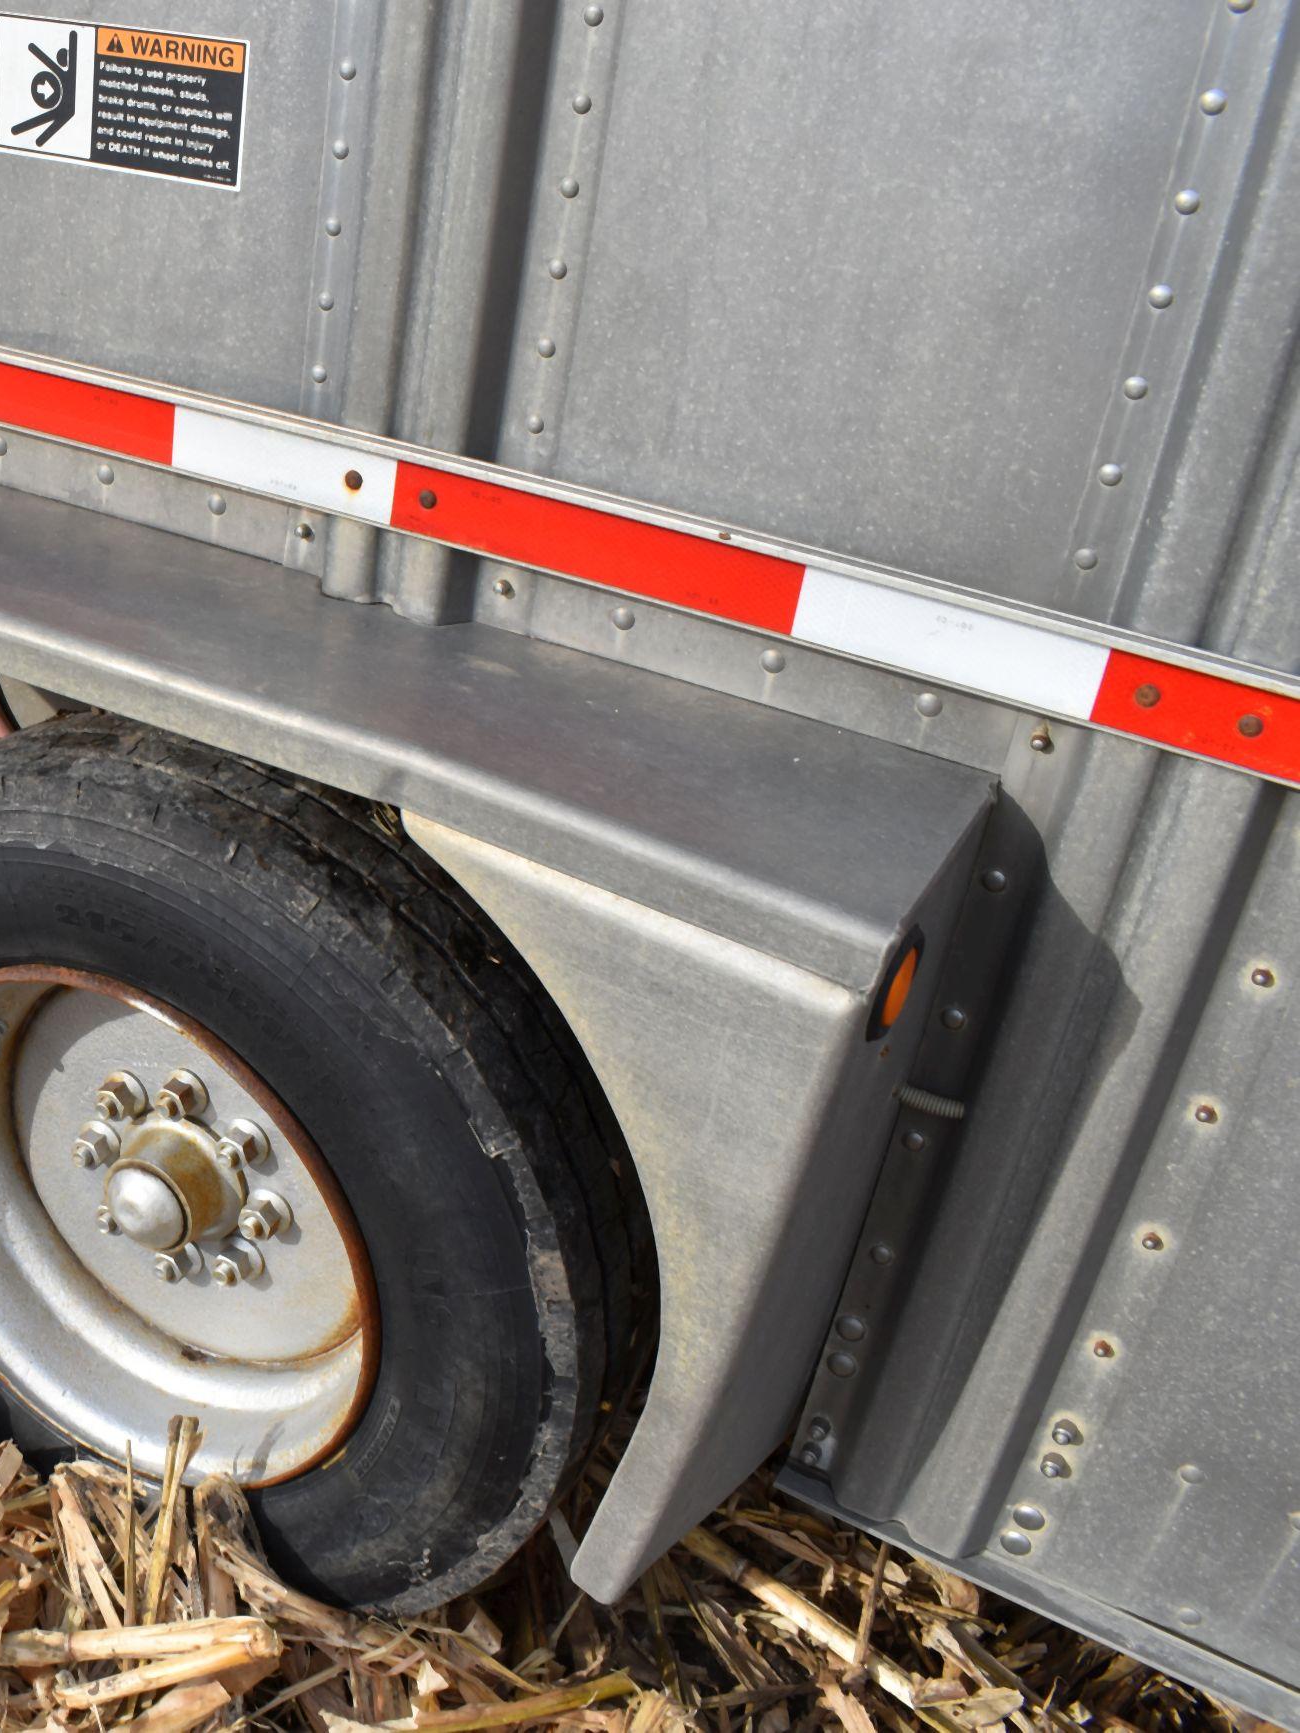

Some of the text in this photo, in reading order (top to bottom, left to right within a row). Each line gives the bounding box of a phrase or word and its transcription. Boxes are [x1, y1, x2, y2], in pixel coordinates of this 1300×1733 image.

[131, 36, 234, 67] WARNING
[100, 62, 206, 86] Failure to use properly
[99, 78, 138, 92] matched
[180, 90, 209, 103] studs,
[99, 94, 124, 106] brake
[162, 104, 172, 112] or
[175, 105, 212, 120] capnuts
[216, 111, 232, 121] will
[98, 111, 123, 122] result
[127, 113, 135, 123] in
[138, 116, 187, 131] equipment
[97, 126, 213, 153] and could result in injury
[96, 142, 106, 150] or
[109, 143, 140, 155] DEATH
[143, 147, 149, 157] if
[153, 150, 179, 161] wheel
[182, 154, 213, 168] comes
